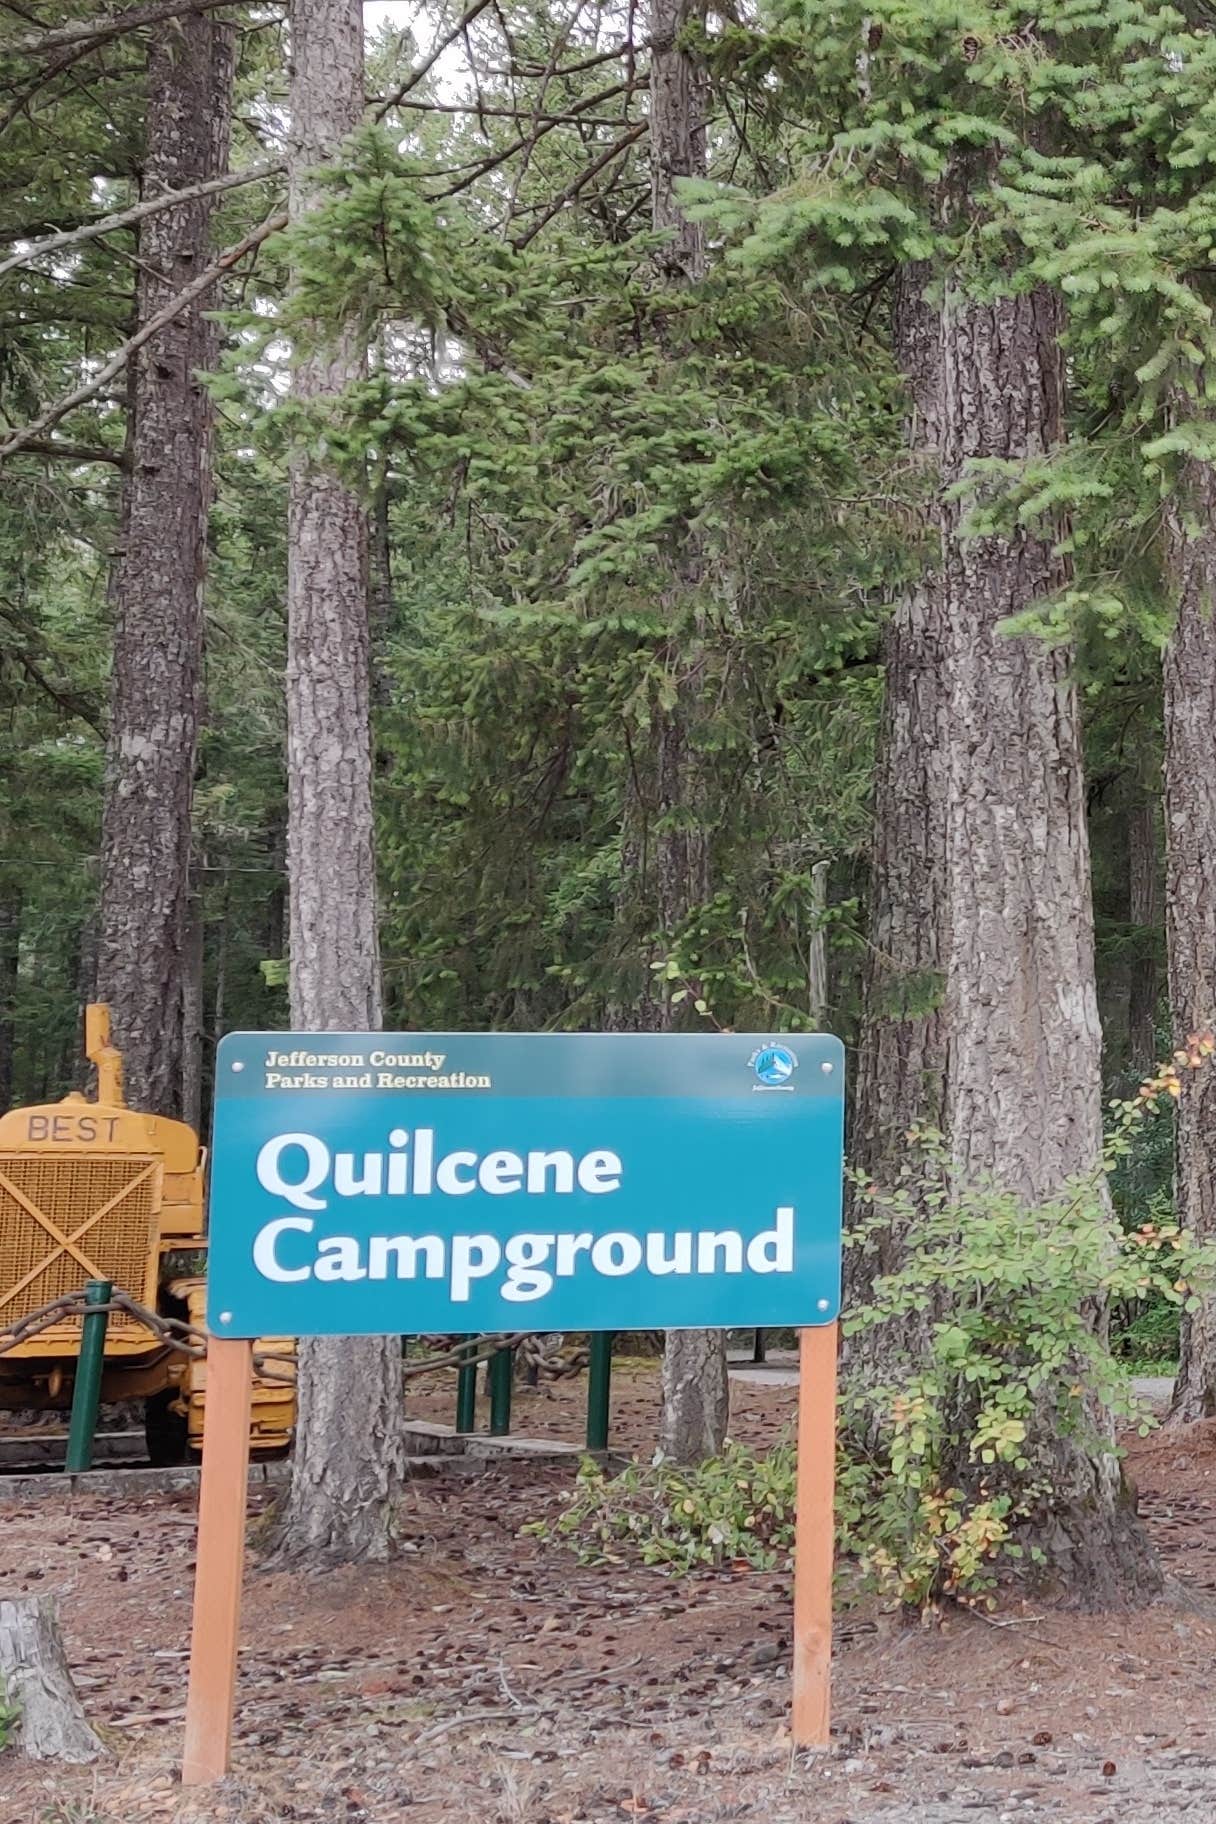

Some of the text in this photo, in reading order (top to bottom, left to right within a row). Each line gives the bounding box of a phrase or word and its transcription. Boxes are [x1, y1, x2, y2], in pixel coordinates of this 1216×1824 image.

[265, 1051, 447, 1070] Jefferson County
[265, 1071, 492, 1089] Parks and Recreation
[27, 1114, 121, 1143] BEST
[255, 1128, 623, 1211] Quilcene
[252, 1206, 796, 1303] Campground
